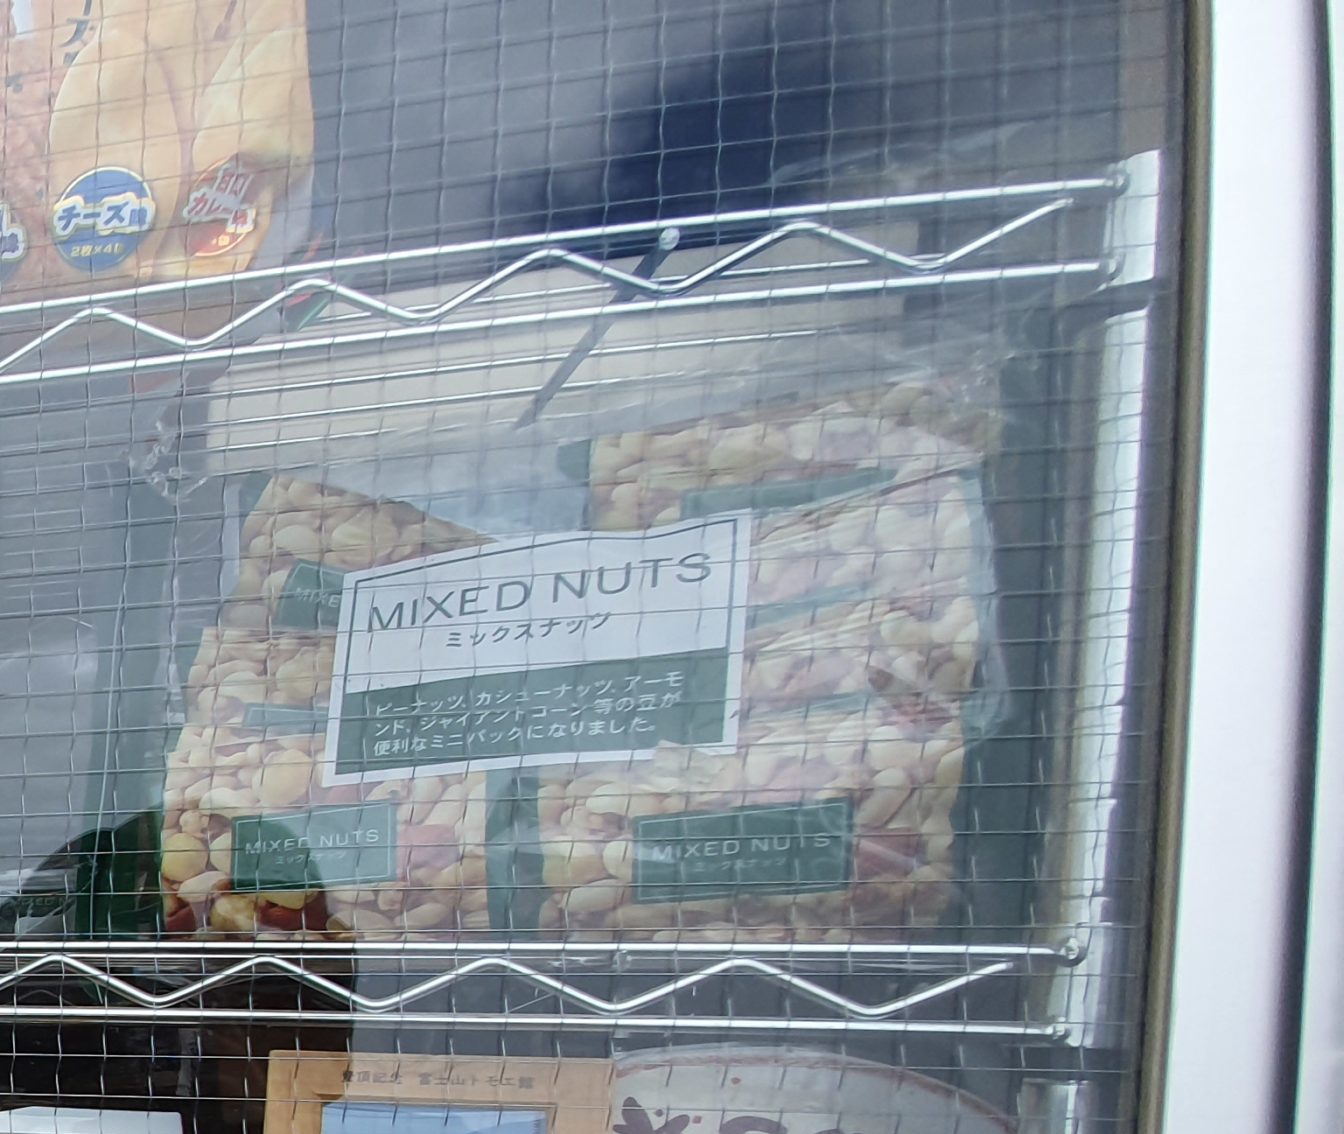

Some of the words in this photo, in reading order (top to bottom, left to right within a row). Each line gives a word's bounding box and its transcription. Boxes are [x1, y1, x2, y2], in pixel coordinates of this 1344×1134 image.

[366, 578, 532, 634] MIXED
[551, 551, 713, 604] NUTS
[445, 611, 612, 650] ミックスナッツ
[319, 829, 380, 847] NUTS
